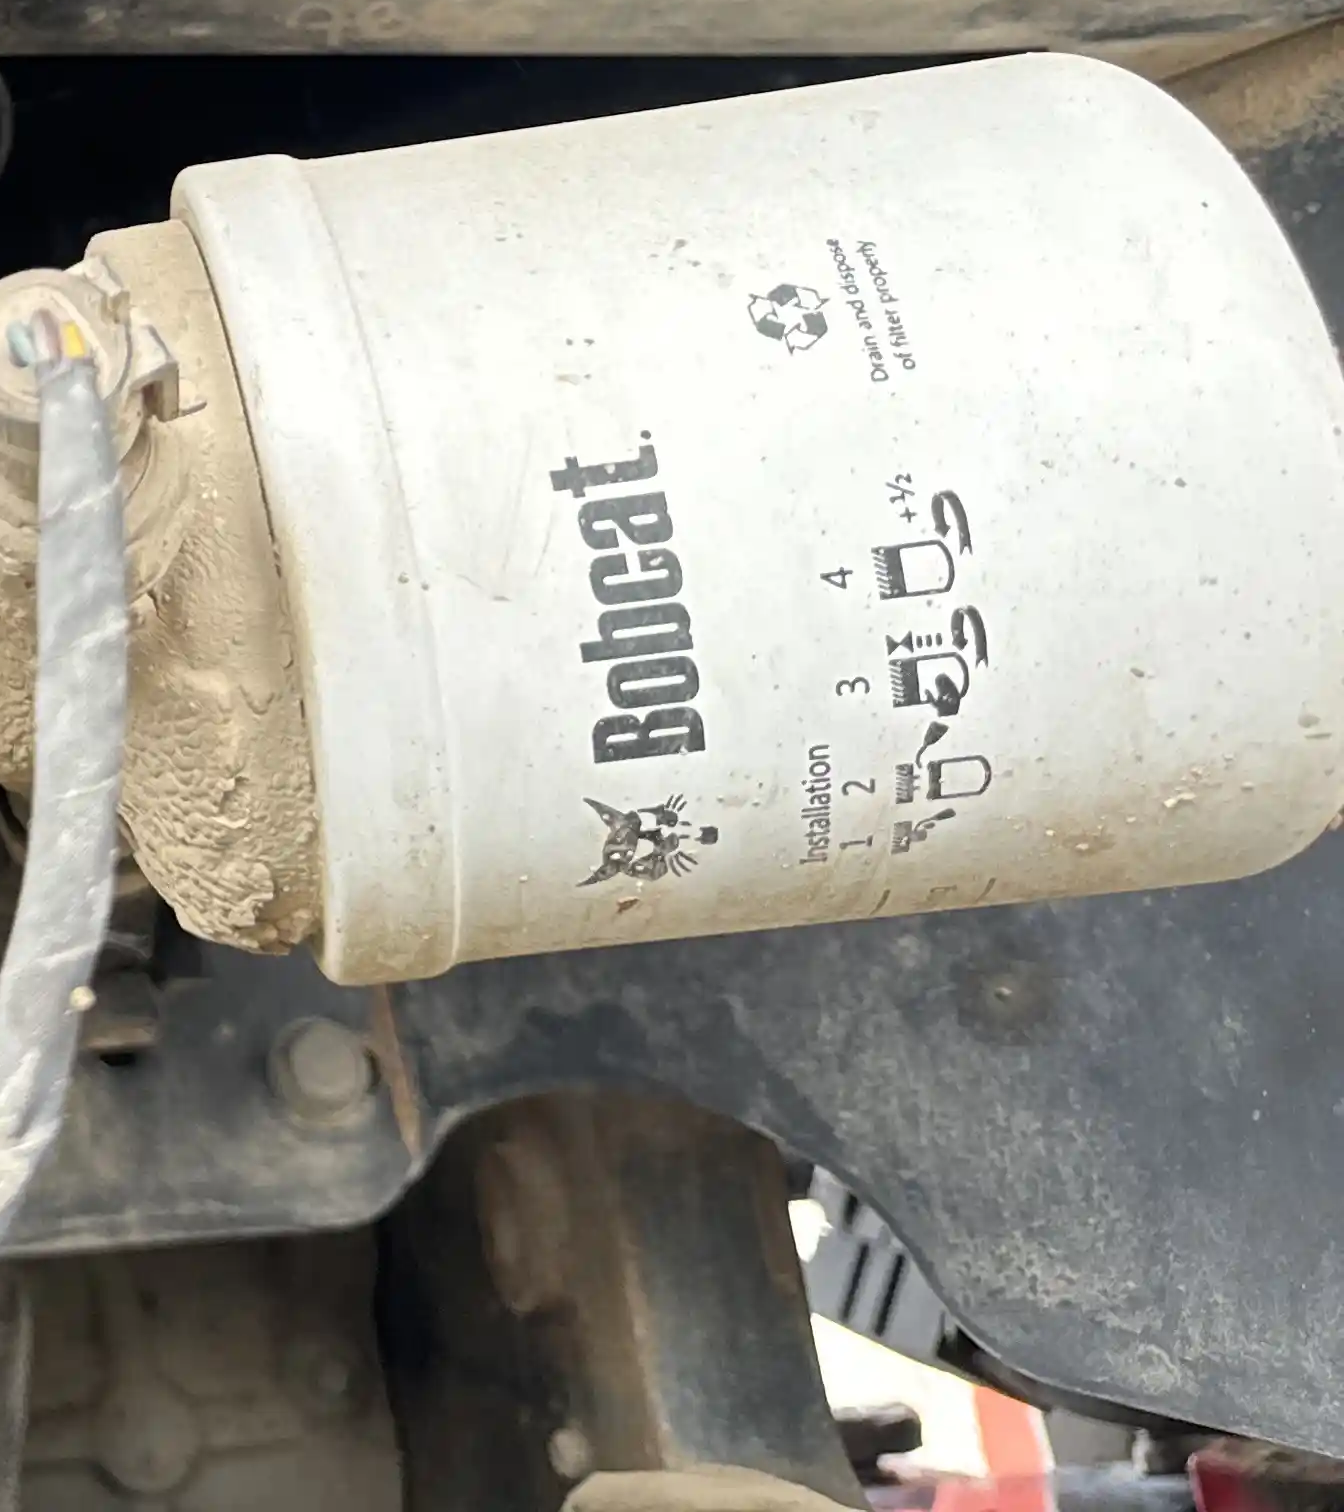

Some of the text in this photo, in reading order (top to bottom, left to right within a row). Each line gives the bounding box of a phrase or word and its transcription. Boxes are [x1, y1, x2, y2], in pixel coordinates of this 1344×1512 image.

[825, 237, 890, 382] Drain and dispose
[855, 239, 916, 370] of filter properly
[819, 565, 876, 850] 1 2 3 4
[799, 742, 832, 865] Installation
